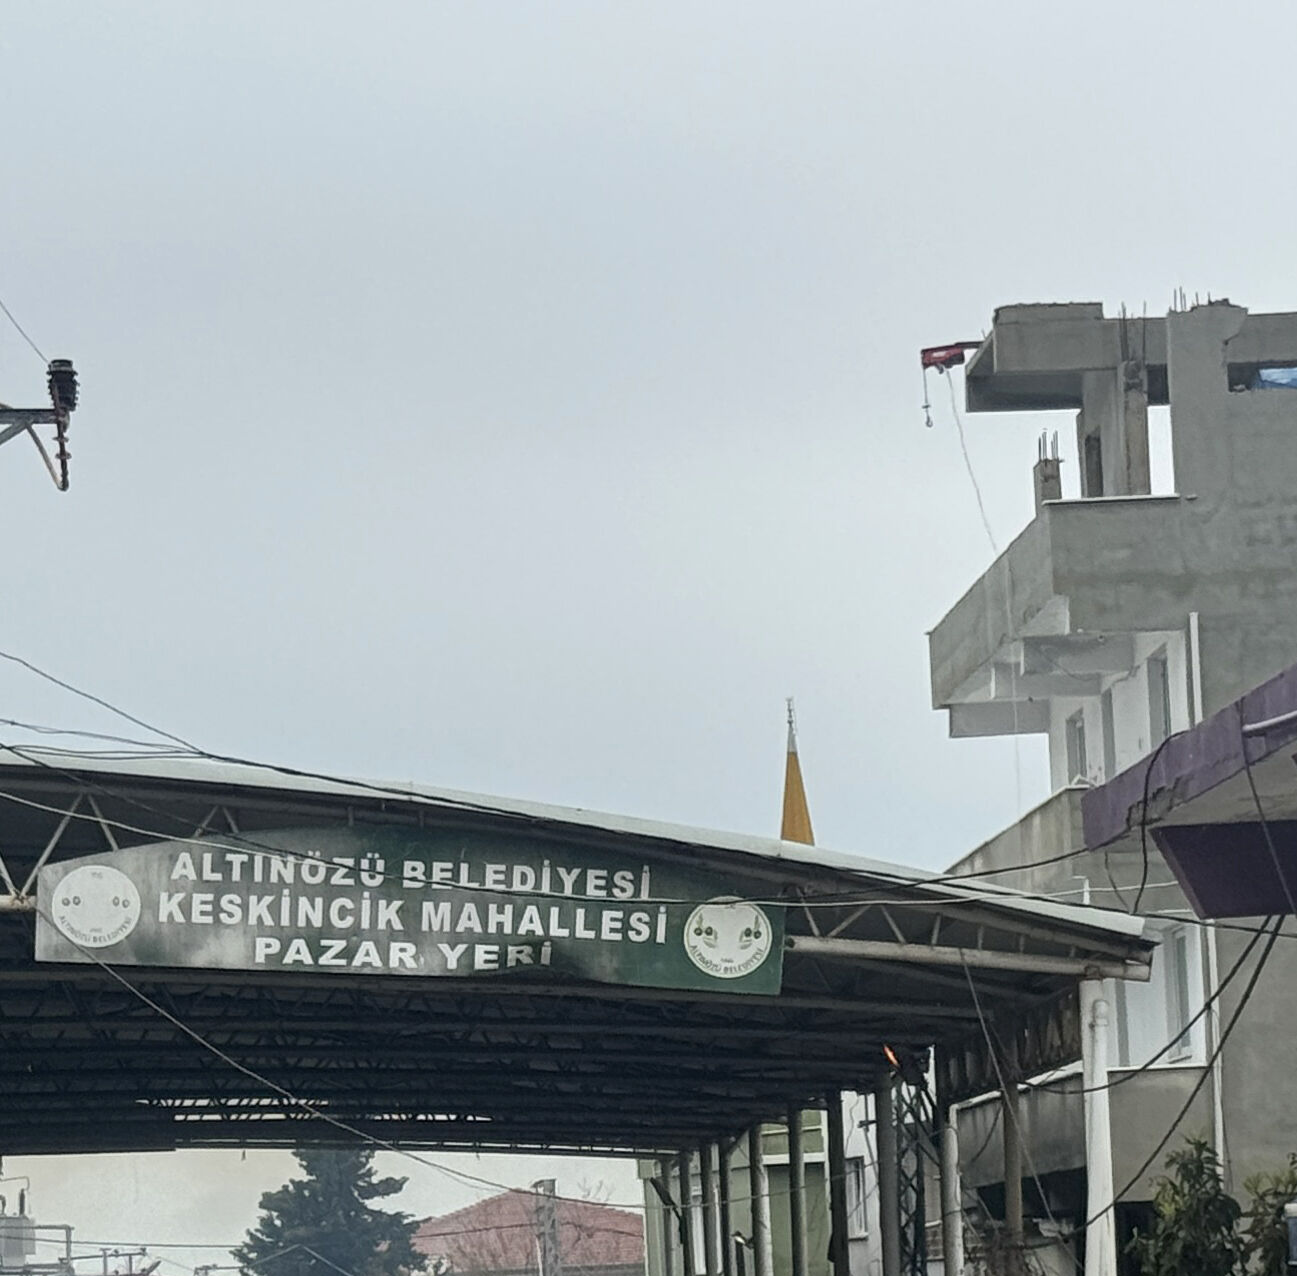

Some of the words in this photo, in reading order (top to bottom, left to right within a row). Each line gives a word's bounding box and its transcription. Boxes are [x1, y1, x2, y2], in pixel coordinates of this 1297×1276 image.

[170, 850, 385, 887] ALTINÖZÜ
[402, 859, 651, 898] BELEDİYESİ
[158, 889, 405, 931] KESKİNCİK
[421, 901, 667, 944] MAHALLESİ
[255, 937, 419, 968] PAZAR
[437, 941, 552, 970] YERİ
